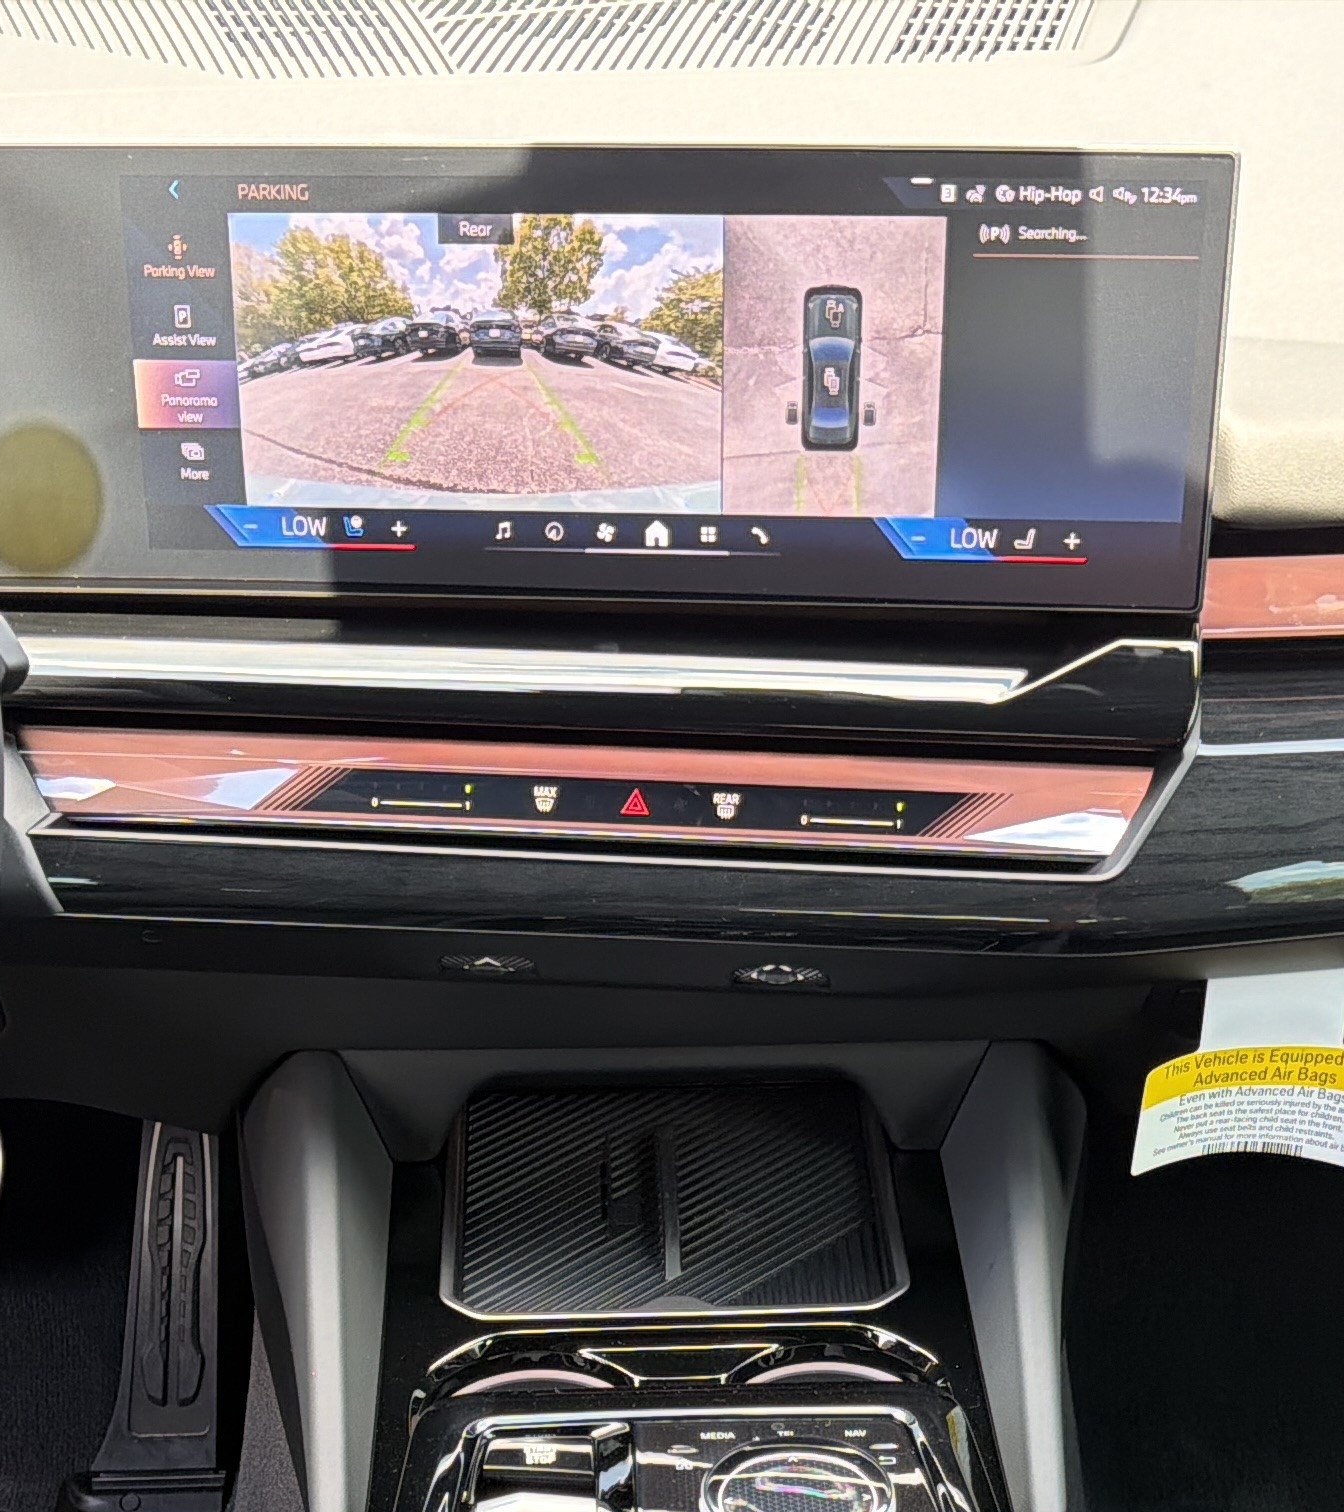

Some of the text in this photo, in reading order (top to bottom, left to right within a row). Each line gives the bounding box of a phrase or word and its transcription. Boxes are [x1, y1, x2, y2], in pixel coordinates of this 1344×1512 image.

[237, 183, 309, 201] PARKING
[1018, 186, 1082, 205] Hip-Hop
[1141, 187, 1197, 205] 12:34pm
[459, 221, 493, 238] Rear
[1018, 225, 1087, 243] Searching...
[143, 263, 216, 280] Parking View
[152, 333, 217, 347] Assist View
[160, 393, 218, 407] Panorama
[177, 410, 204, 423] view
[180, 467, 210, 480] More
[281, 516, 327, 537] LOW
[950, 528, 998, 549] LOW
[534, 785, 558, 798] MAX
[713, 793, 740, 805] REAR
[1164, 1061, 1191, 1079] This
[1194, 1050, 1248, 1070] Vehicle
[1252, 1050, 1265, 1064] is
[1269, 1049, 1344, 1066] Equipped
[1193, 1066, 1337, 1087] Advanced Air Bags
[1178, 1093, 1206, 1106] Even
[1208, 1087, 1233, 1099] with
[1235, 1085, 1295, 1097] Advanced
[1296, 1086, 1315, 1098] Air
[1189, 1105, 1203, 1114] can
[1204, 1102, 1214, 1110] be
[1247, 1098, 1281, 1107] seriously
[1283, 1099, 1311, 1109] injured
[1312, 1099, 1322, 1111] by
[1323, 1102, 1336, 1113] the
[1209, 1110, 1225, 1119] seat
[1234, 1107, 1247, 1115] the
[1248, 1107, 1273, 1115] safest
[1275, 1108, 1296, 1117] place
[1297, 1109, 1309, 1117] for
[1310, 1110, 1344, 1124] children.
[1258, 1115, 1278, 1123] child
[1280, 1116, 1298, 1124] seat
[1298, 1117, 1306, 1126] in
[1307, 1118, 1321, 1128] the
[1204, 1127, 1218, 1135] use
[1219, 1125, 1236, 1133] seat
[1258, 1124, 1273, 1132] and
[1275, 1124, 1294, 1133] child
[1296, 1126, 1335, 1140] restraints.
[1223, 1133, 1234, 1141] for
[1258, 1132, 1304, 1143] information
[1305, 1137, 1329, 1149] about
[1329, 1142, 1339, 1150] air
[700, 1431, 736, 1440] MEDIA
[844, 1429, 867, 1438] NAV
